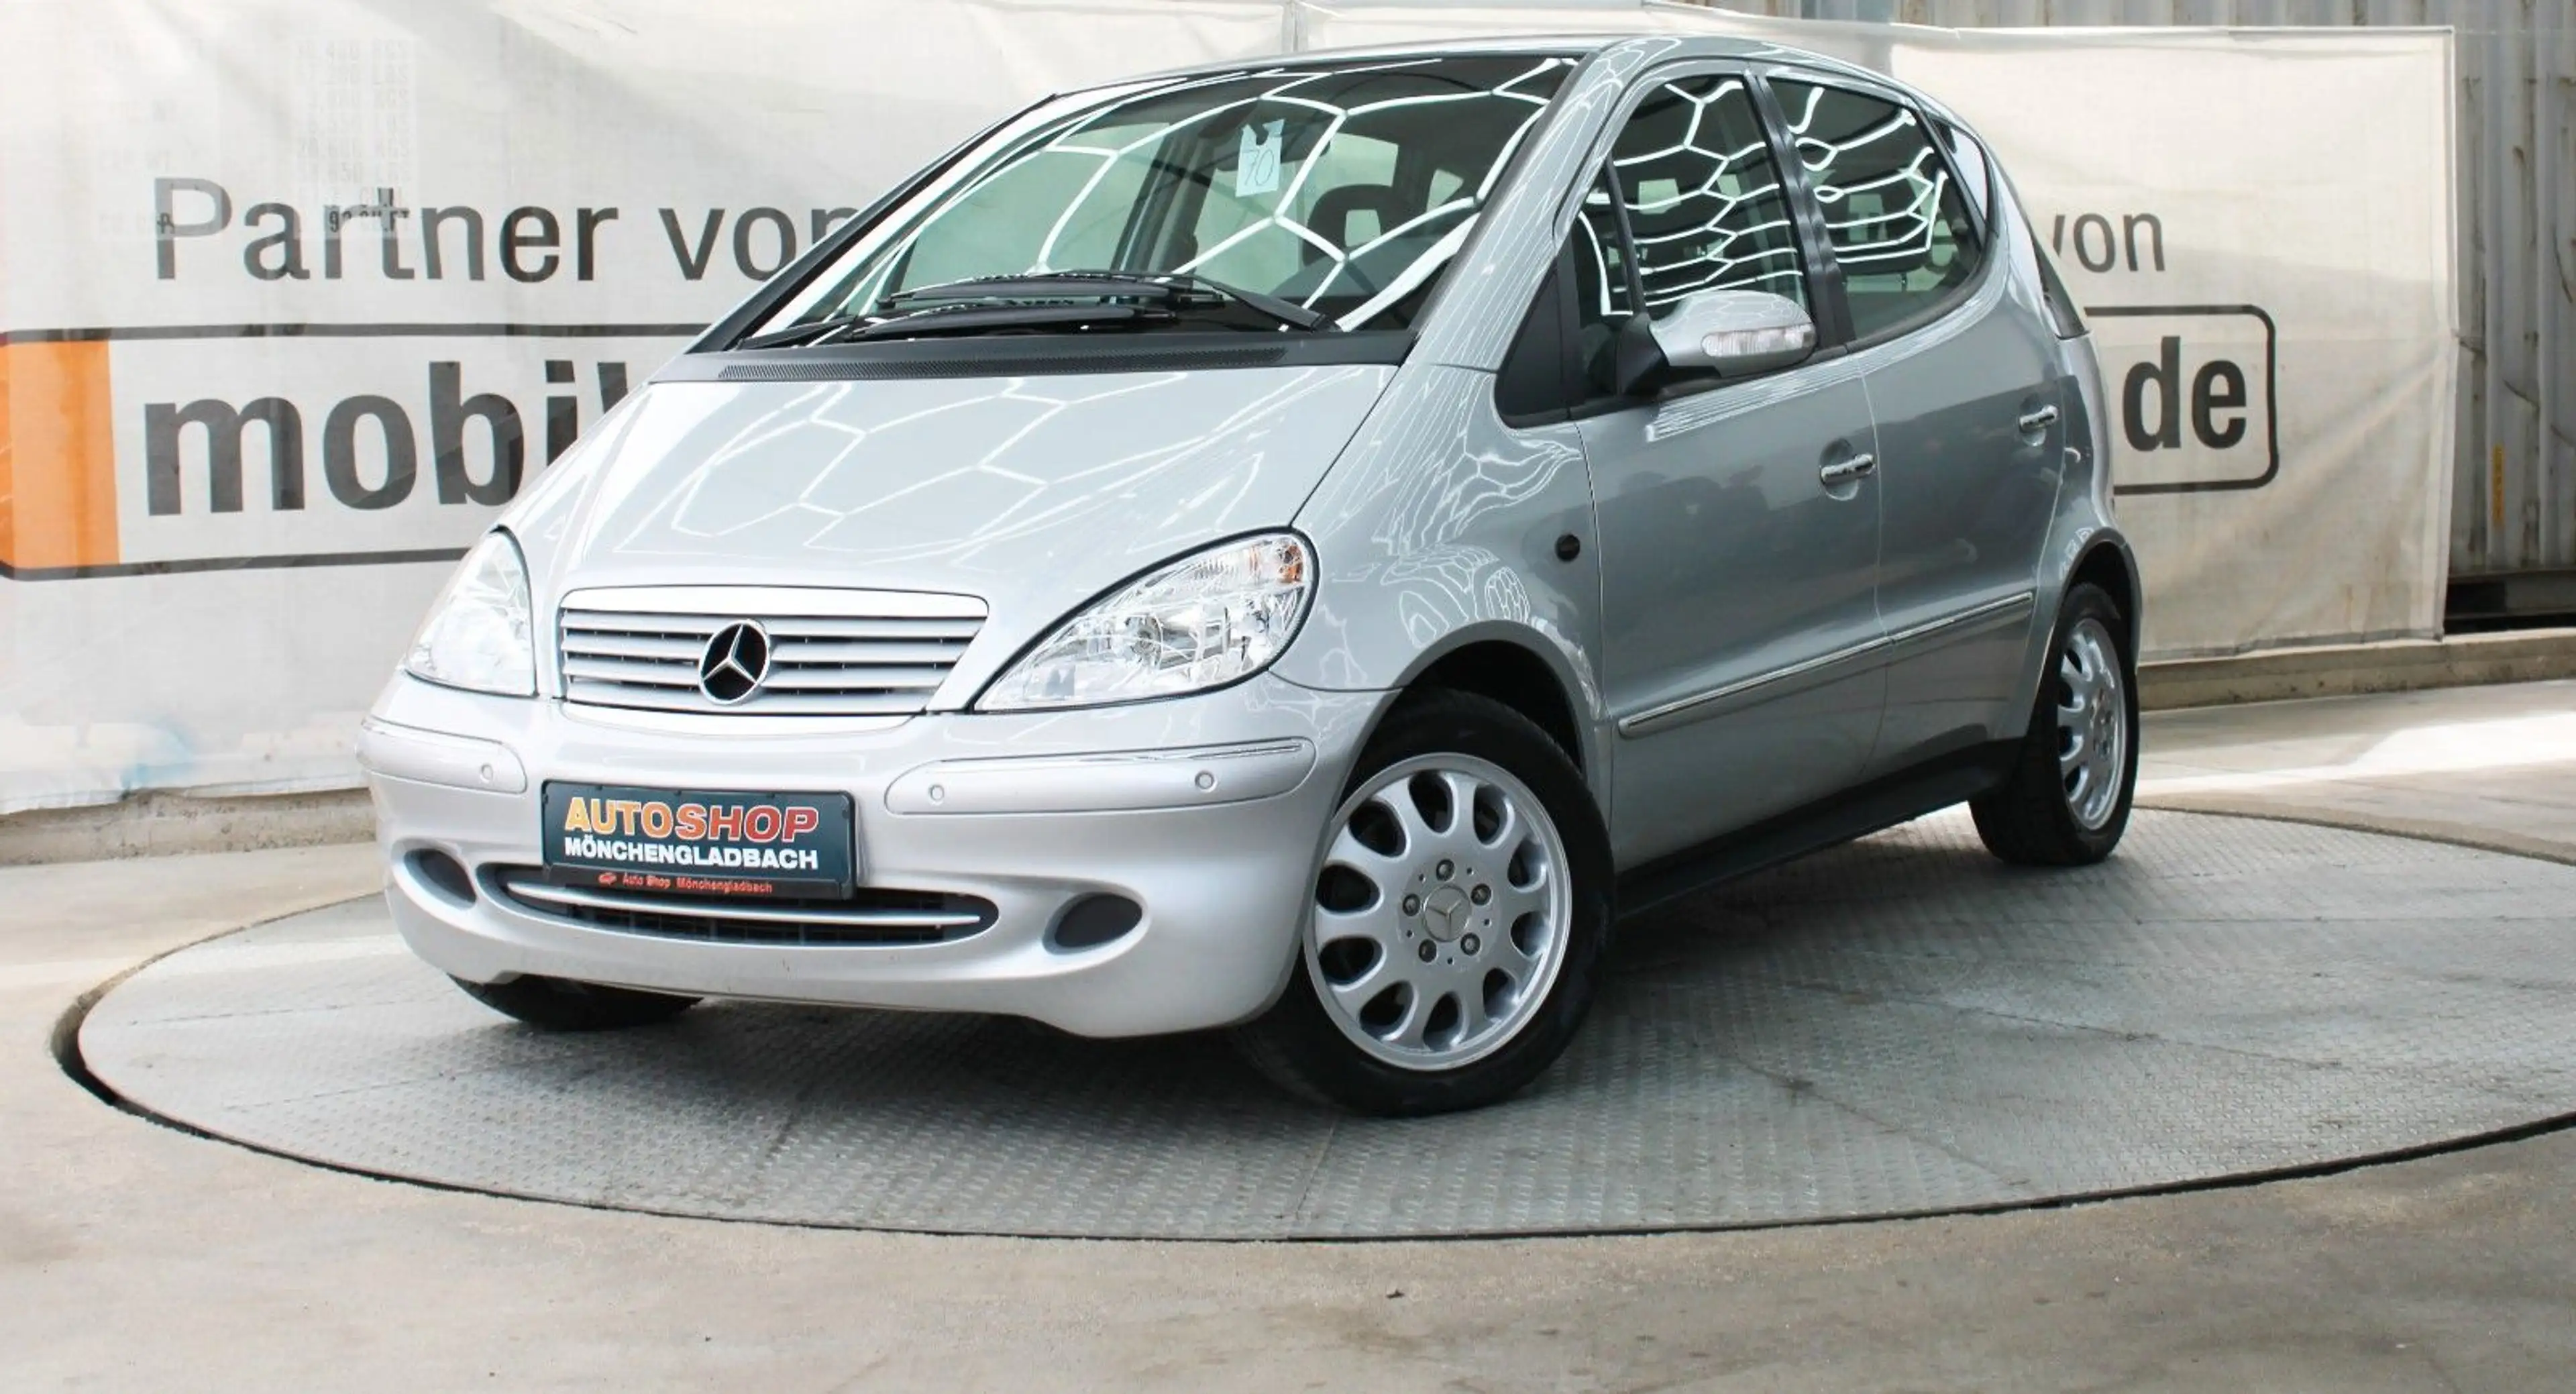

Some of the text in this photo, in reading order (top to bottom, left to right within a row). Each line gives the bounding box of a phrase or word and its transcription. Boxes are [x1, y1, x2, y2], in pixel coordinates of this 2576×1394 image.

[1243, 148, 1275, 186] 70
[155, 178, 619, 283] Partner
[2123, 335, 2247, 452] de
[144, 360, 629, 516] mobi
[564, 835, 819, 870] MÖNCHENGLADBACH
[623, 873, 773, 894] Auto Shop Mönchengladbach
